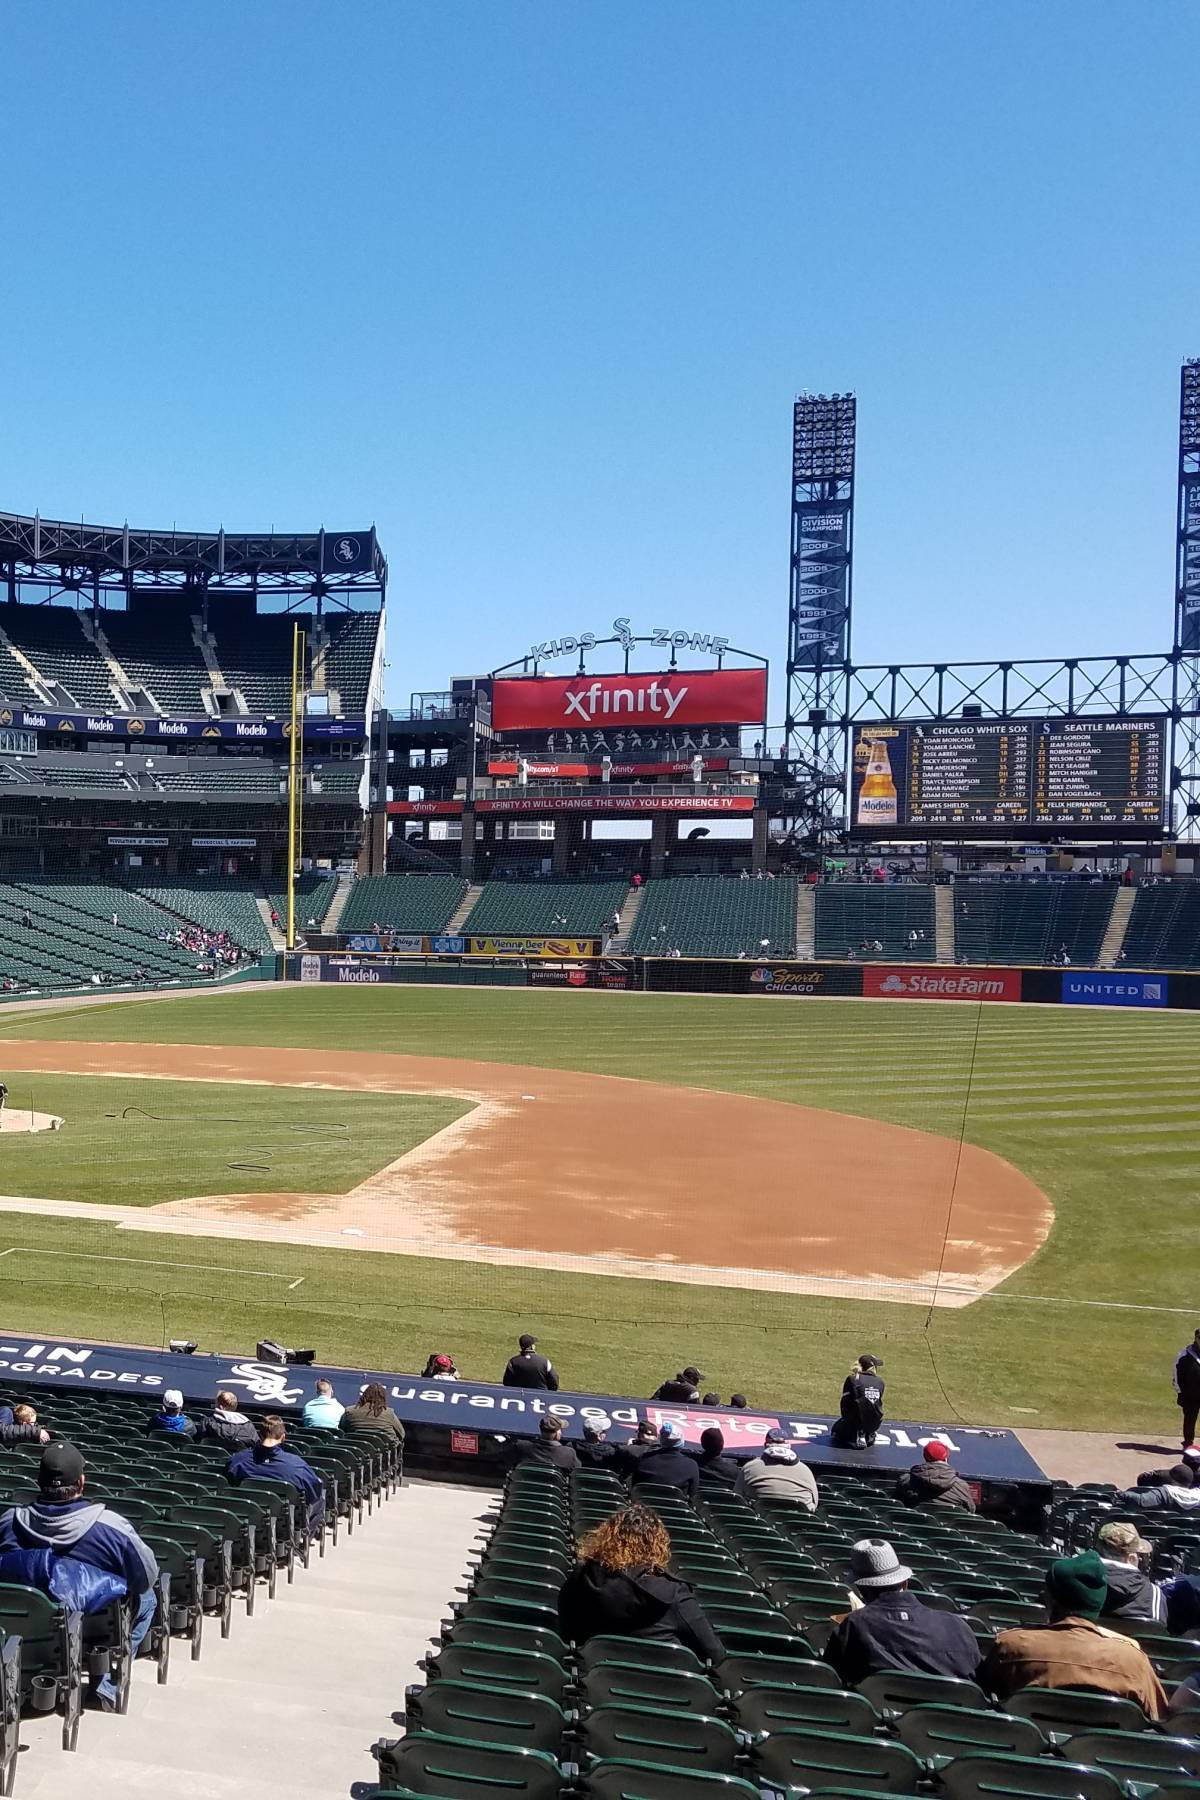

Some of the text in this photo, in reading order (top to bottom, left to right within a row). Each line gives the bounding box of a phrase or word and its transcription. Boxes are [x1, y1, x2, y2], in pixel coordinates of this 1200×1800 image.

[802, 518, 843, 527] DIVISION
[531, 632, 596, 663] KIDS
[650, 628, 729, 656] ZONE
[564, 681, 688, 721] xfinity
[23, 711, 46, 726] Modelo
[87, 716, 114, 731] Modelo
[159, 719, 188, 734] Modelo
[236, 722, 268, 735] Modelo
[976, 726, 1006, 734] WHITE
[1009, 725, 1028, 733] SOX
[1064, 722, 1156, 732] SEATTLE MARINERS
[611, 765, 635, 776] xfinity
[412, 802, 438, 812] xfinity
[491, 798, 733, 809] XFINITY X1 WILL CHANGE THE WAY YOU EXPERIENCE TV
[863, 801, 892, 810] Modelo
[526, 940, 546, 948] Beef
[338, 968, 380, 982] Modelo
[532, 972, 568, 980] guaranteed
[773, 968, 824, 984] Sports
[765, 984, 814, 992] CHICAGO
[1070, 983, 1139, 995] UNITED
[650, 1410, 780, 1434] Rate
[788, 1421, 960, 1451] Feld
